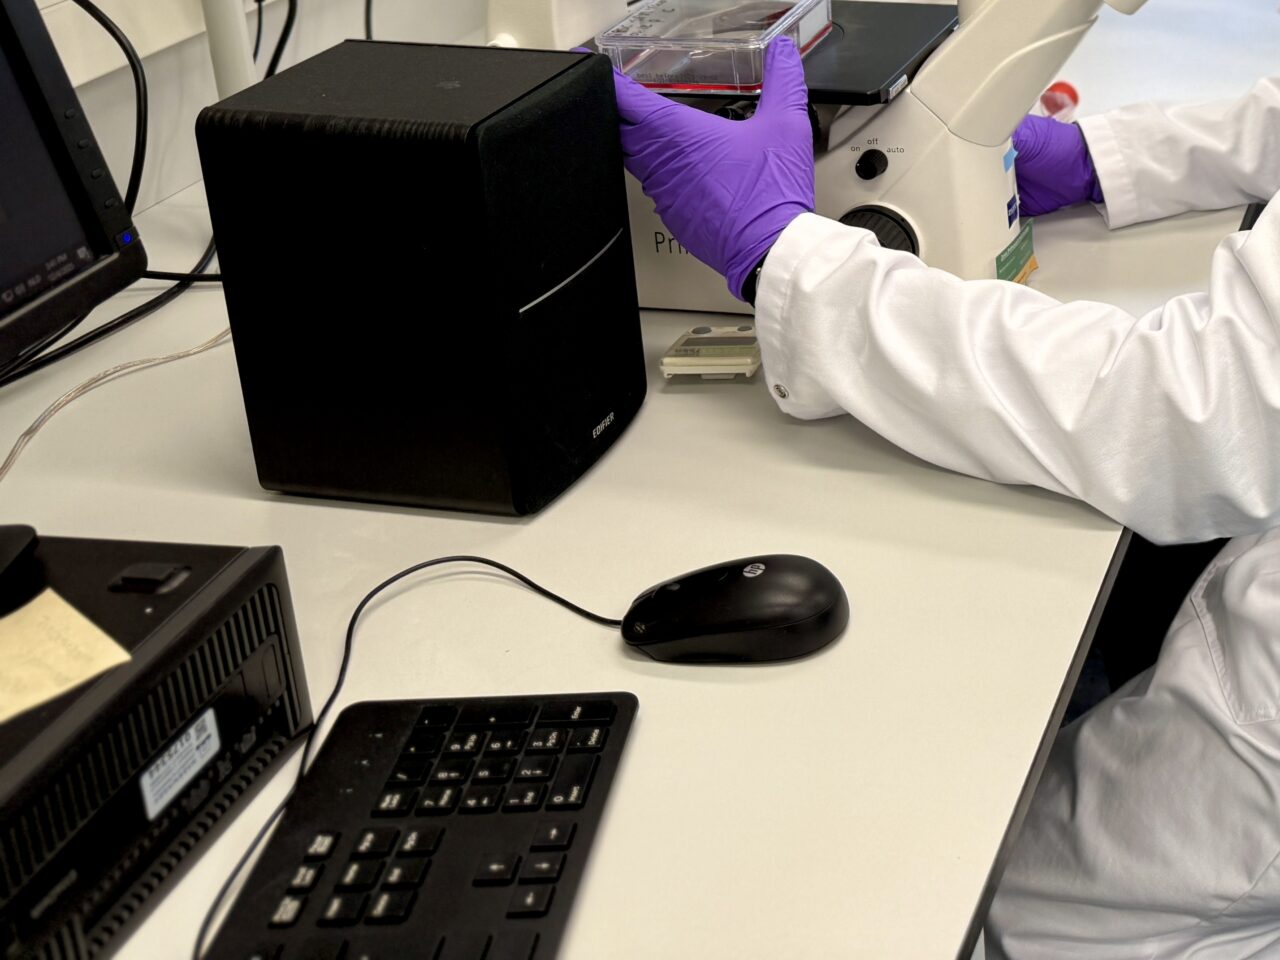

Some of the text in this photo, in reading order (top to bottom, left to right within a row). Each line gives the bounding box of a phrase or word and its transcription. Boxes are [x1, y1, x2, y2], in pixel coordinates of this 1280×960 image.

[866, 137, 879, 145] off
[886, 146, 905, 154] auto
[490, 742, 501, 750] 6
[553, 795, 564, 803] 0
